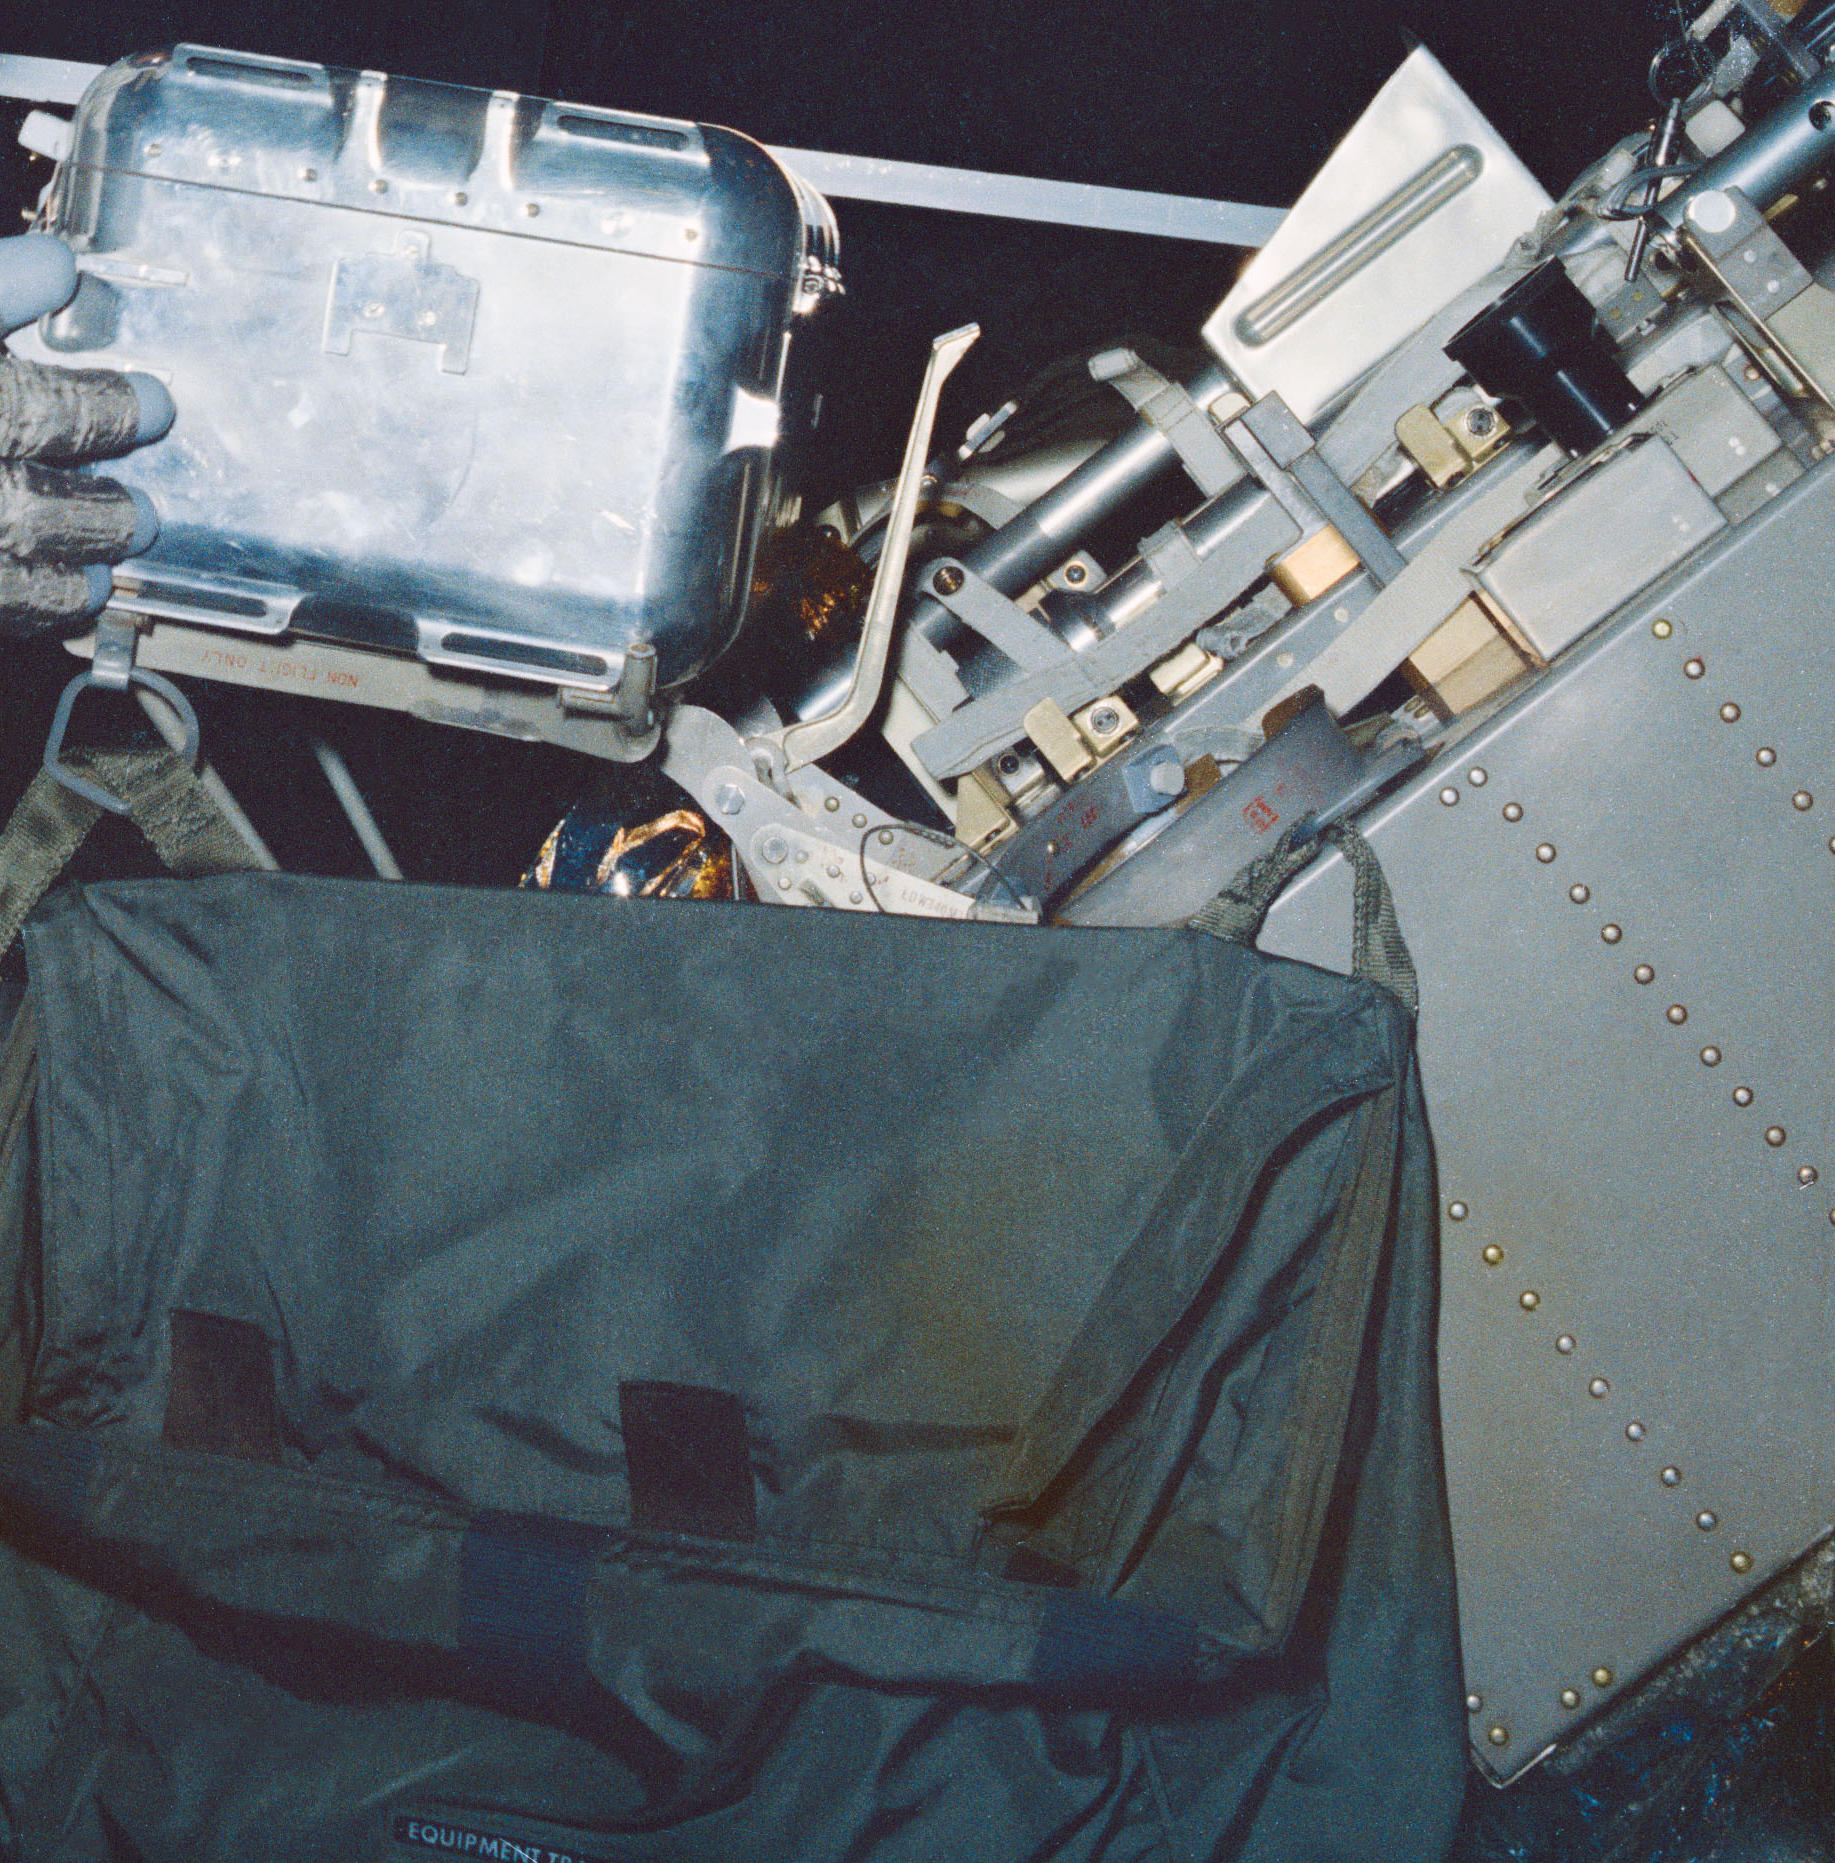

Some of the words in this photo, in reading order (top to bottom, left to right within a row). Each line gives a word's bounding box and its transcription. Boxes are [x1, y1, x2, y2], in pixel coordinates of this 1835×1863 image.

[200, 649, 248, 669] ONLY
[326, 670, 359, 688] NON
[407, 1821, 542, 1863] EQUIPMENT
